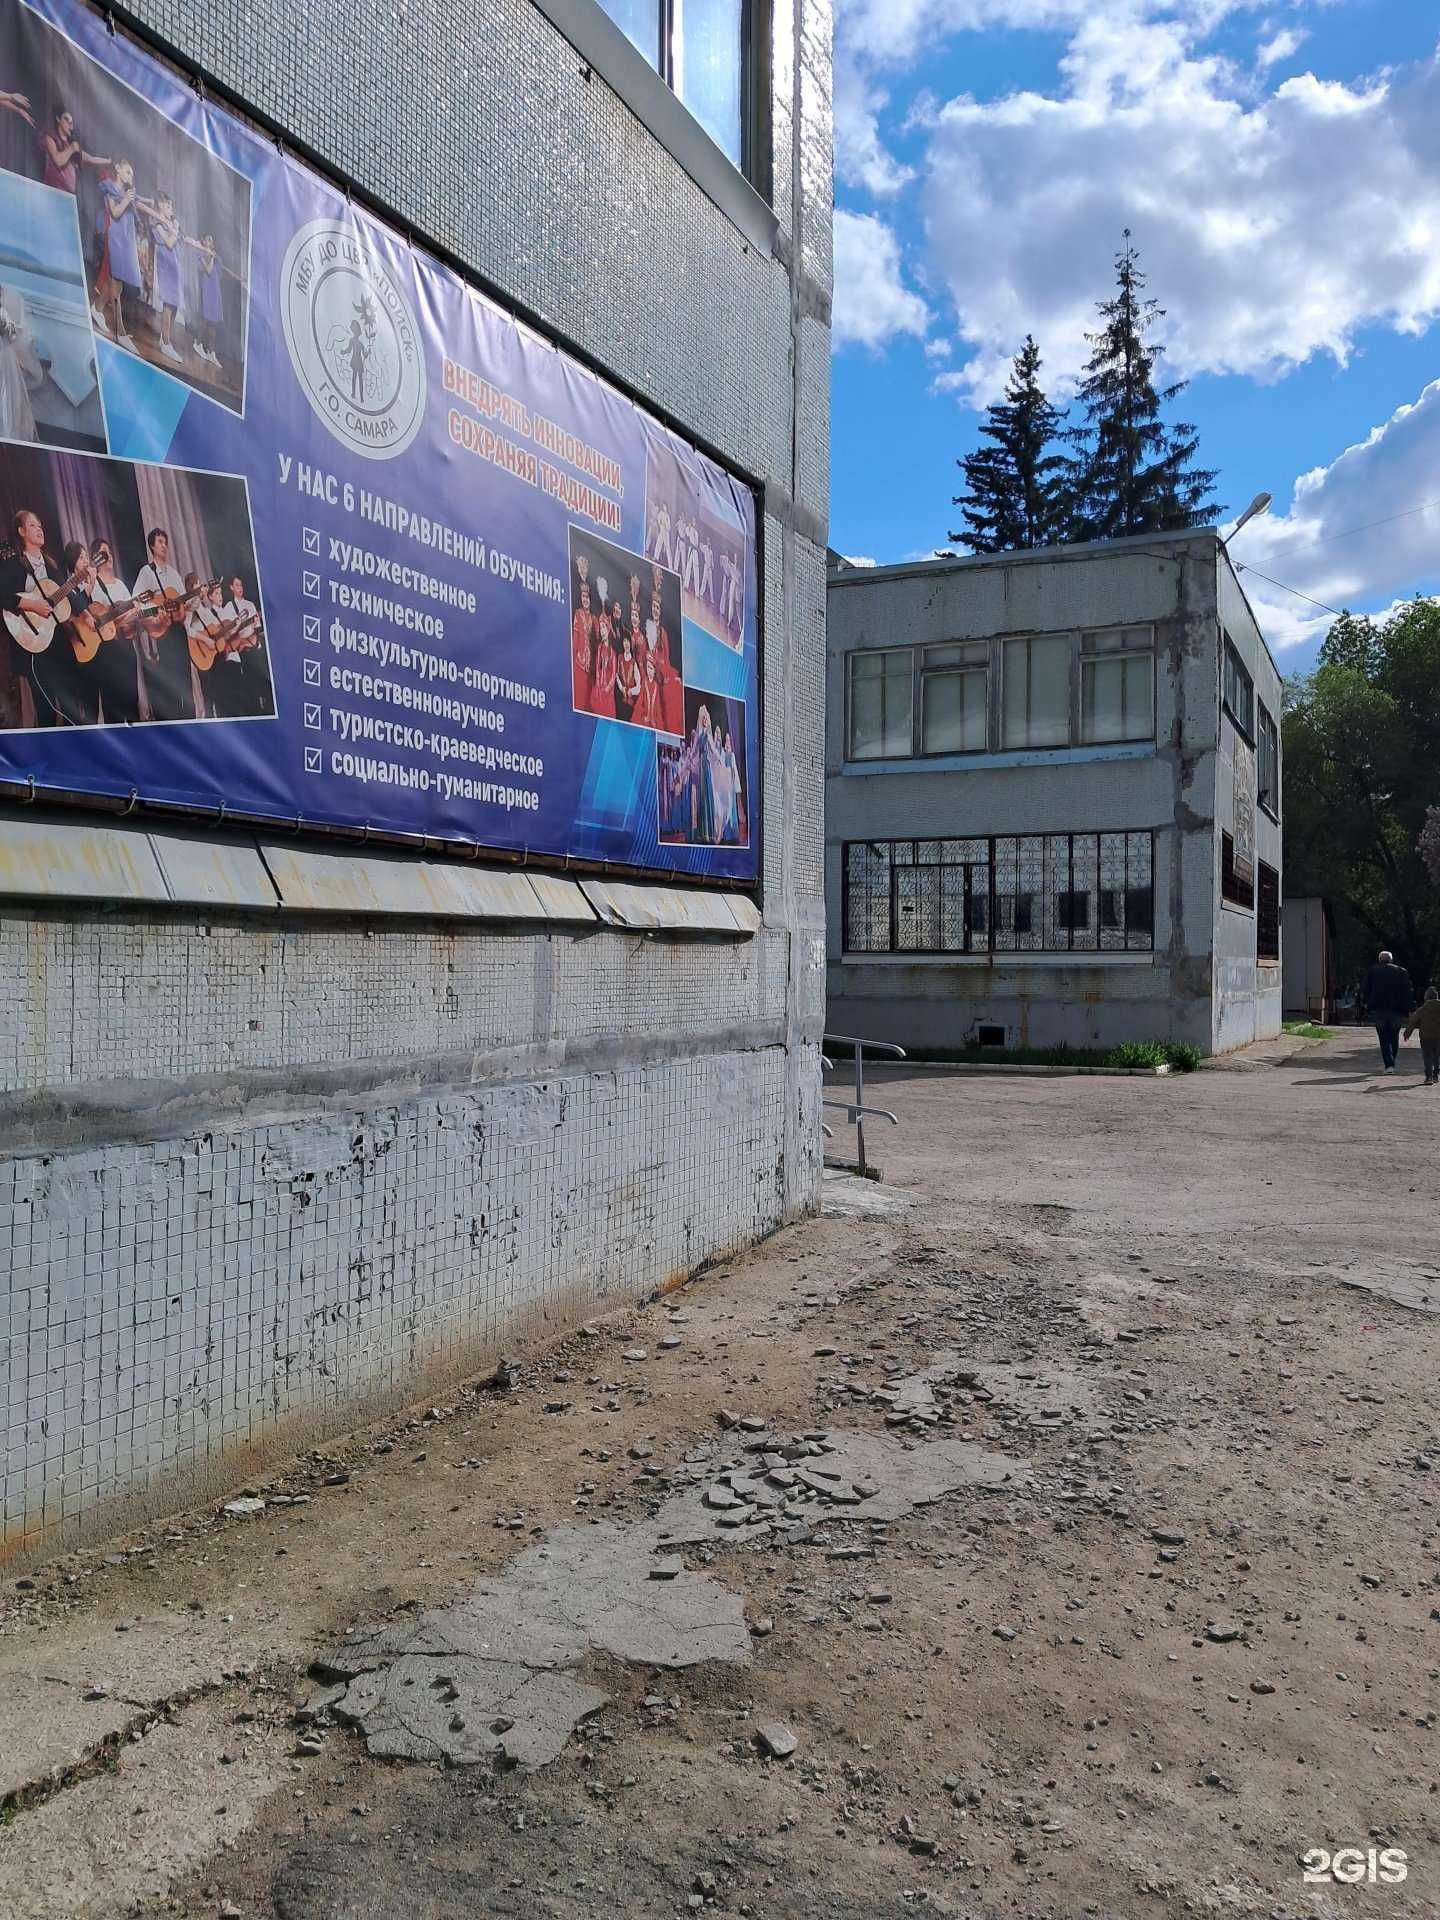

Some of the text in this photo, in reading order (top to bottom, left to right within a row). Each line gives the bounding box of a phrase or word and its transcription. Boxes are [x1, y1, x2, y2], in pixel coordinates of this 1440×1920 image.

[296, 254, 315, 296] МБУ
[319, 240, 338, 265] ДО
[345, 412, 398, 439] САМАРА
[442, 356, 624, 499] ВНЕДРЯТЬ ИННОВАЦИИ,
[448, 408, 622, 534] СОХРАНЯЯ ТРАДИЦИИ!
[278, 452, 565, 605] У НАС 6 НАПРАВЛЕНИЙ ОБУЧЕНИЯ:
[329, 537, 477, 614] художественное
[329, 579, 444, 640] техническое
[329, 617, 546, 709] физкультурно-спортивное
[330, 666, 505, 733] естественнонаучное
[329, 708, 544, 777] туристско-краеведческое
[331, 751, 539, 811] социально-гуманитарное
